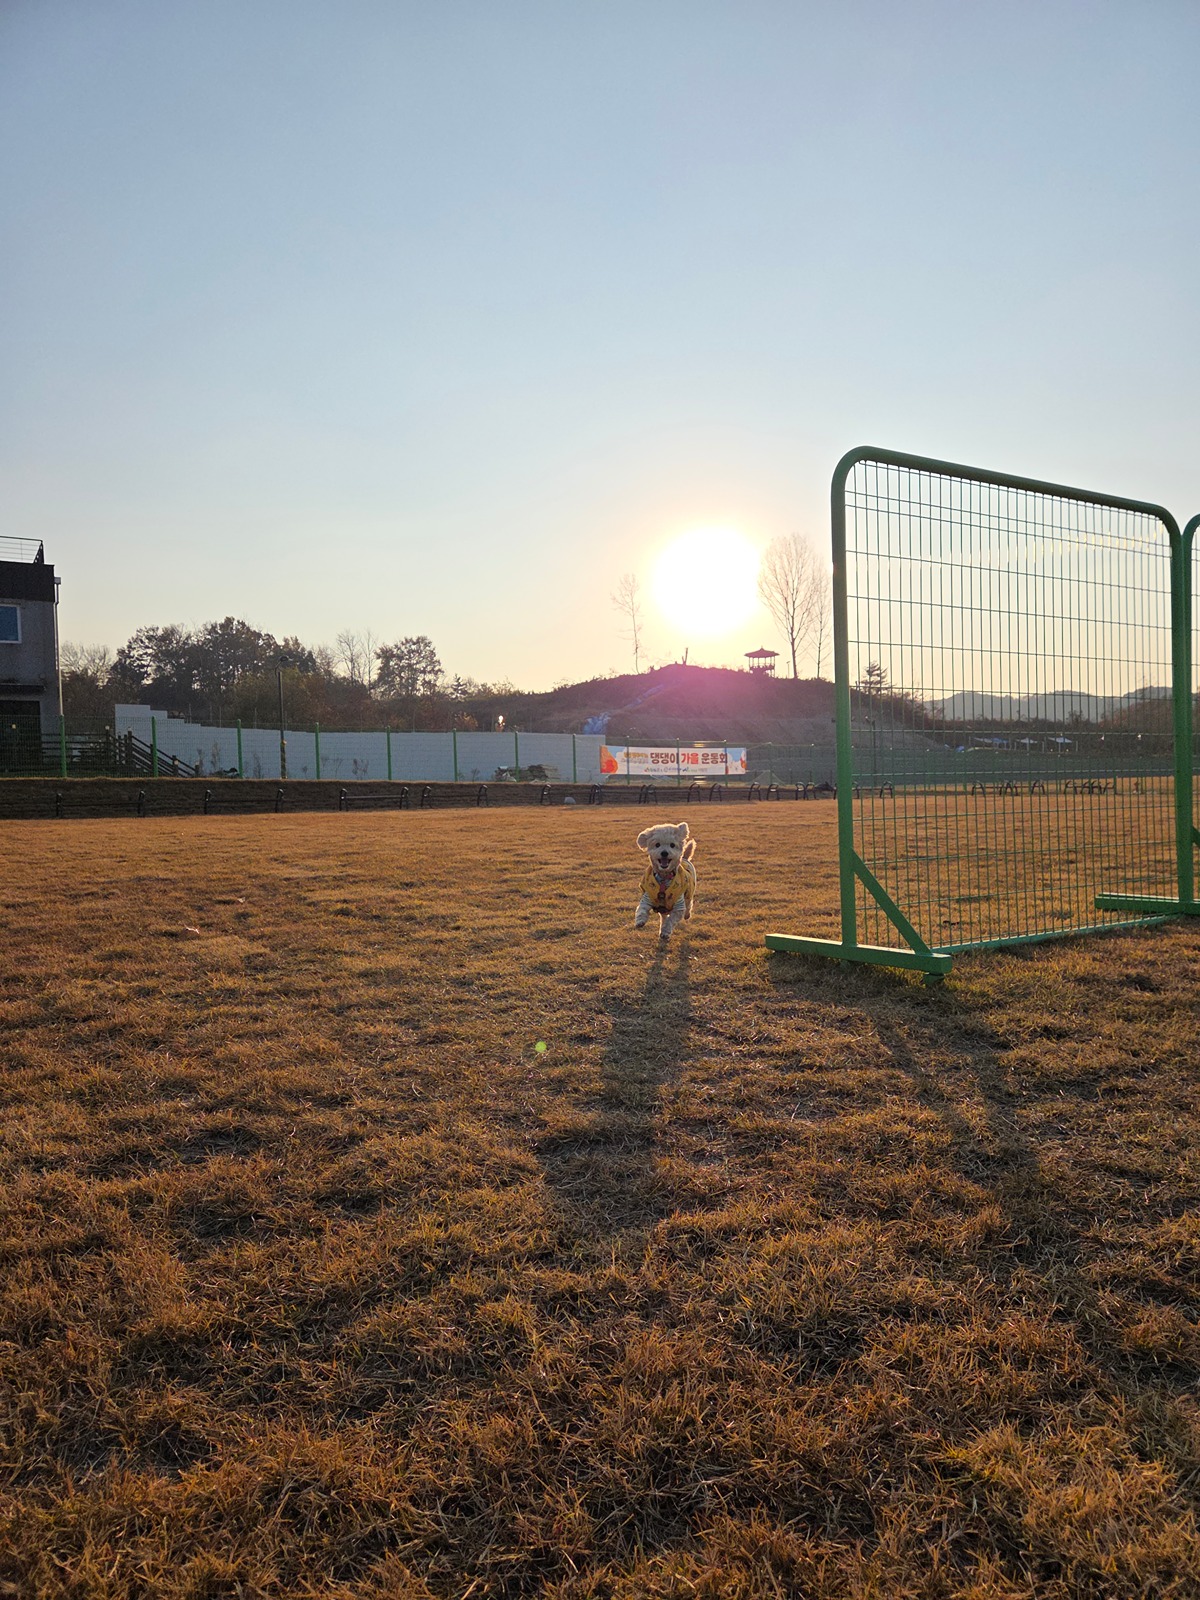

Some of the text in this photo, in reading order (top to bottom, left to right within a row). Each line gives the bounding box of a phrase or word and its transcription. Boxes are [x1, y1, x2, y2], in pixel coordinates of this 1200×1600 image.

[650, 752, 679, 764] 댕댕이
[681, 752, 699, 764] 가을
[701, 752, 728, 764] 운동회
